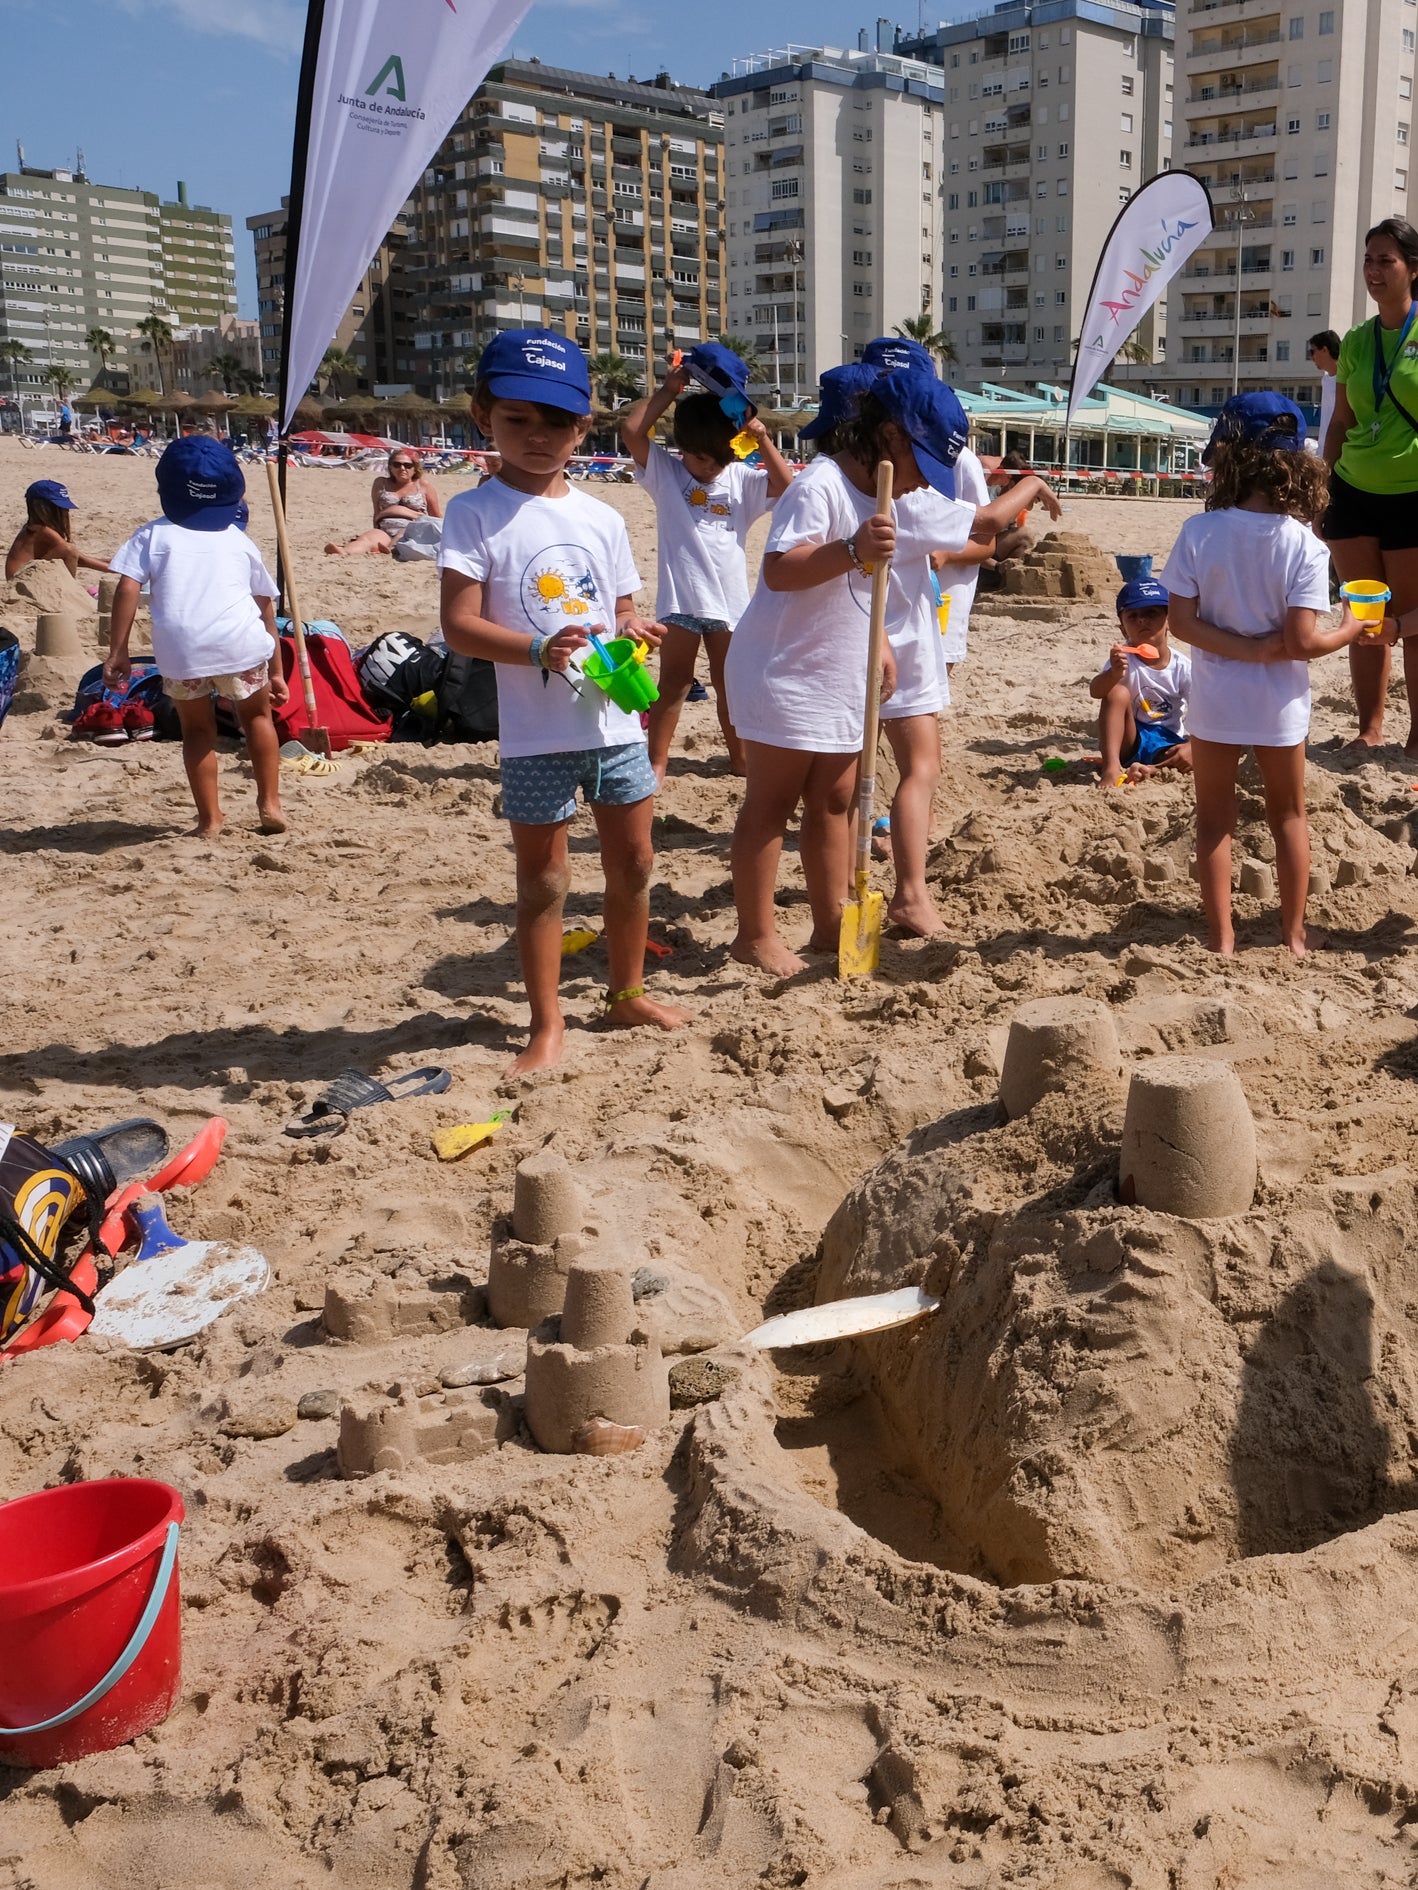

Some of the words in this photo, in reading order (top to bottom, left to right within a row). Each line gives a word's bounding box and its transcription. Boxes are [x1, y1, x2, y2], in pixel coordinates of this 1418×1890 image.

[337, 93, 366, 109] Junta
[369, 102, 383, 113] de
[385, 105, 426, 120] Andalucía
[349, 111, 383, 125] Consejería
[356, 122, 380, 134] Cultura
[1099, 218, 1199, 327] Andalucía
[526, 338, 566, 353] Fundación
[525, 353, 566, 371] Cajasol
[885, 358, 910, 369] Cajasol
[189, 489, 217, 499] Cajasol
